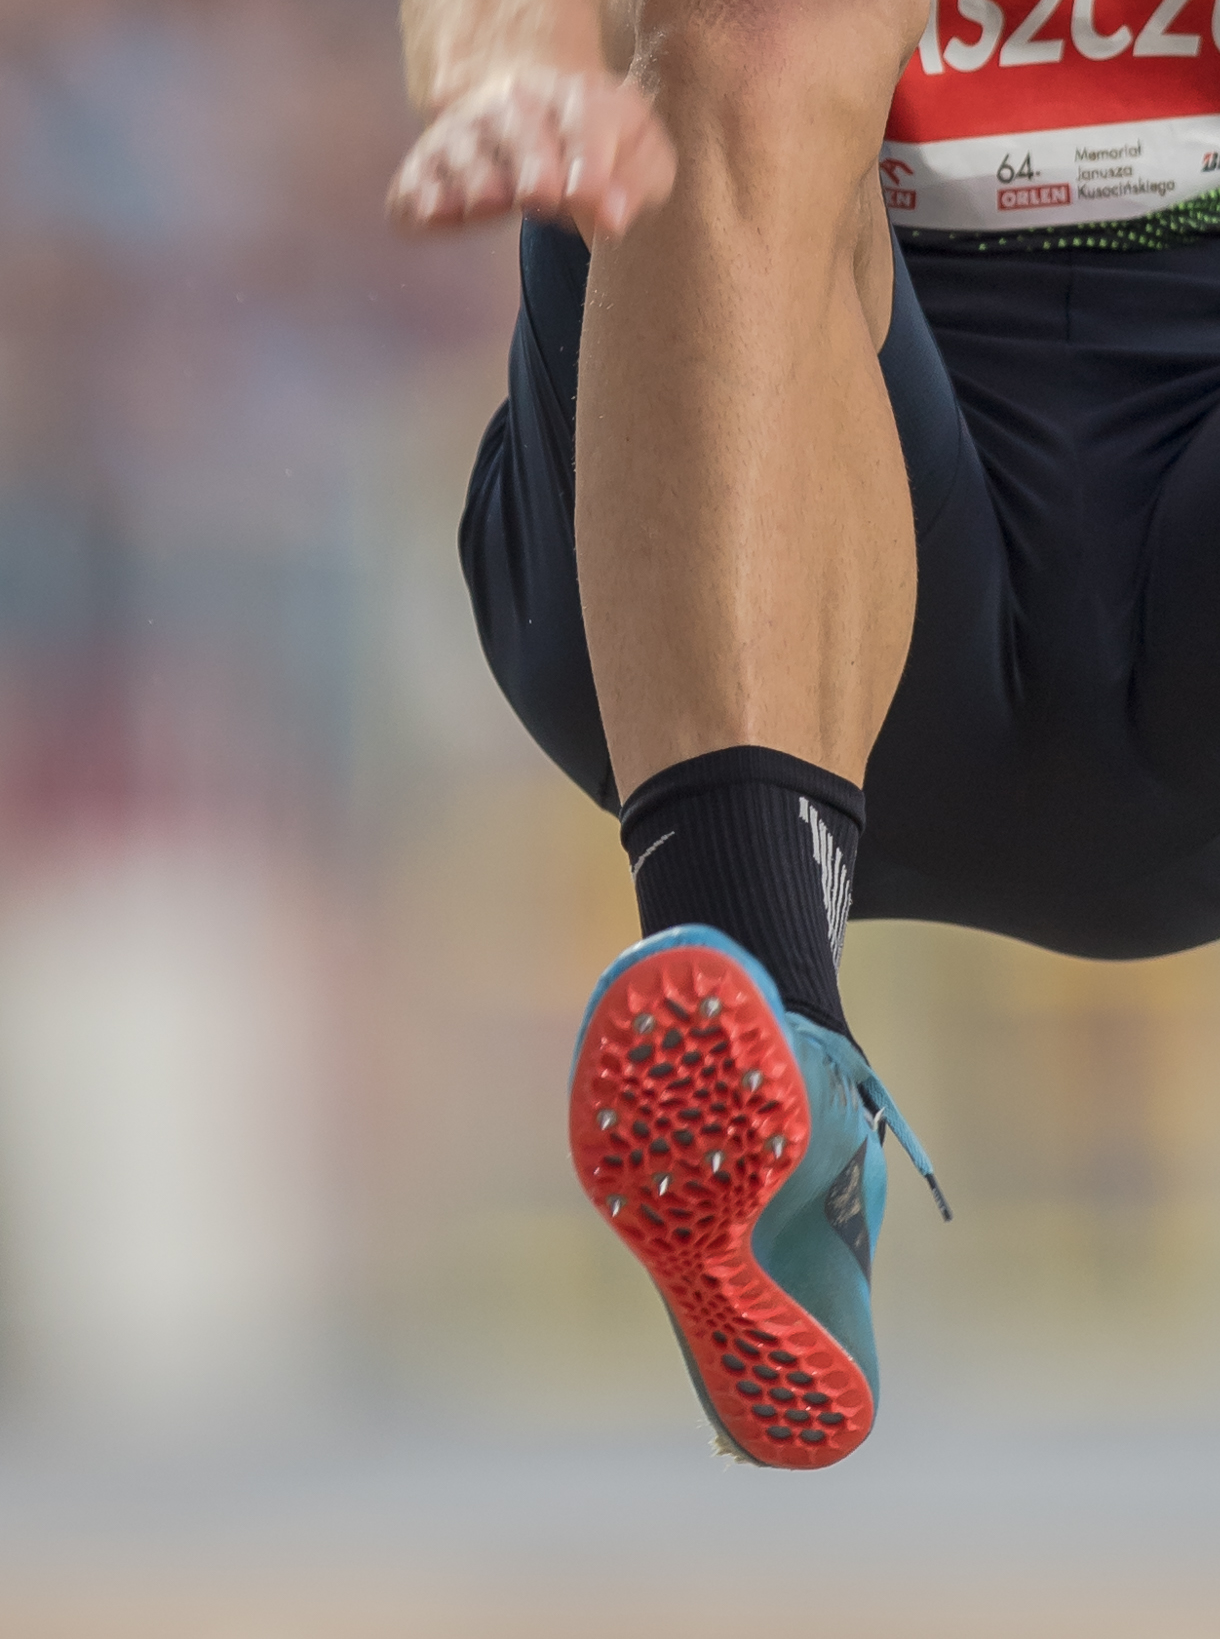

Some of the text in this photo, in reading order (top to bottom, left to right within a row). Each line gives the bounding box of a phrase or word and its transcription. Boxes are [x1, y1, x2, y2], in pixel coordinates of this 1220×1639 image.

[997, 153, 1041, 184] 64.
[1077, 165, 1133, 181] Janusza
[1000, 186, 1068, 208] ORLEN
[1077, 178, 1176, 200] Kusocińskiego
